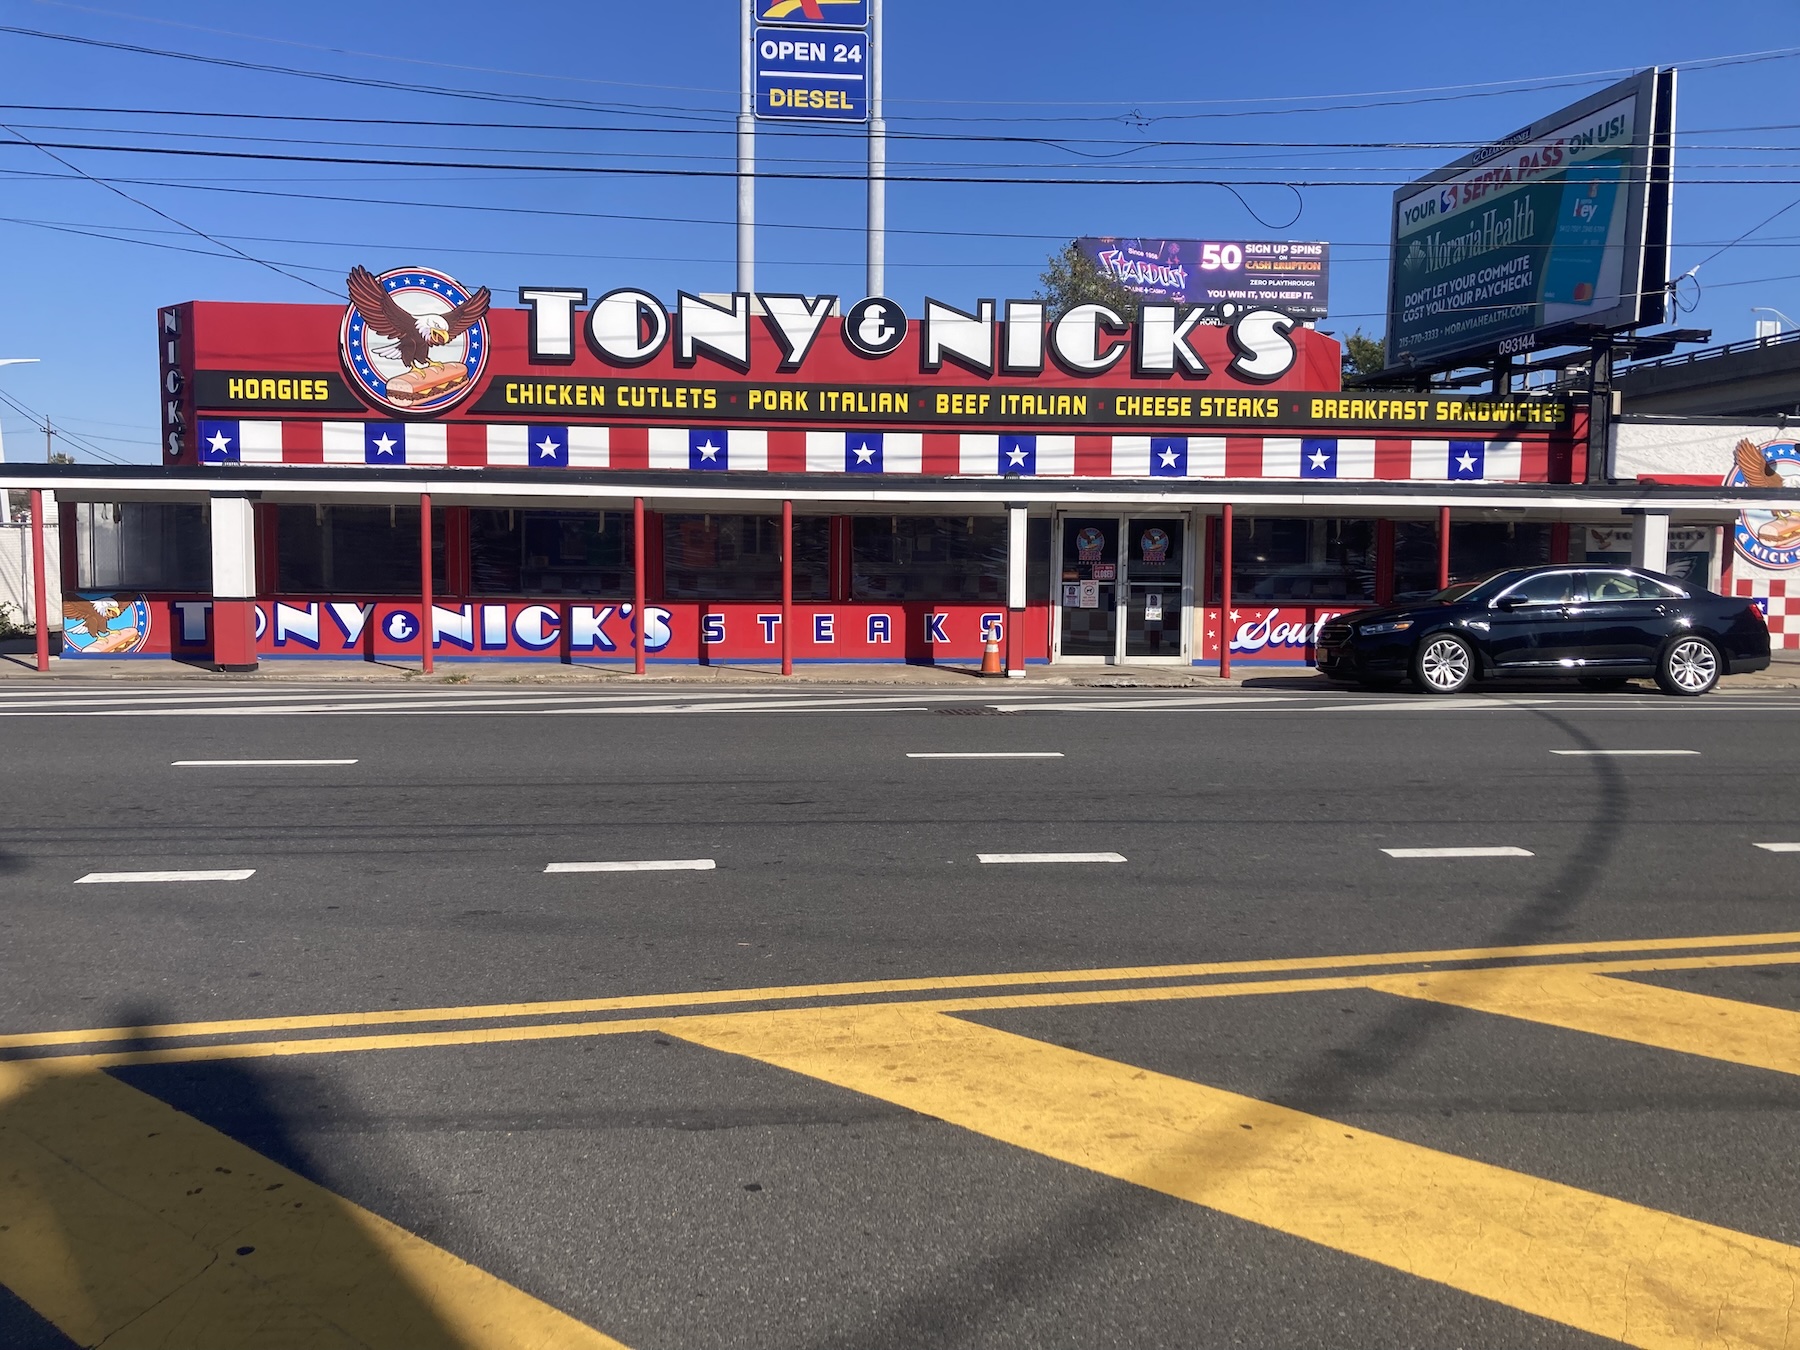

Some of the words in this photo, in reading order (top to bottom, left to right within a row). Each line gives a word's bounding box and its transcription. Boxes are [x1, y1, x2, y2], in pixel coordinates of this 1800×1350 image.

[760, 40, 826, 62] OPEN
[833, 44, 862, 63] 24
[769, 88, 854, 110] DIESEL
[1404, 199, 1436, 226] YOUR
[1462, 164, 1512, 205] SEPTA
[1516, 139, 1564, 181] PASS
[1569, 128, 1594, 155] ON
[1597, 114, 1625, 143] US!
[1128, 247, 1145, 257] Since
[1200, 243, 1243, 272] 50
[1245, 245, 1271, 255] SIGN
[1273, 245, 1288, 255] UP
[1290, 245, 1323, 255] SPINS
[1245, 261, 1271, 271] CASH
[1273, 261, 1322, 271] ERUPTION
[1404, 287, 1431, 308] DON'T
[1432, 279, 1449, 299] LET
[1449, 273, 1477, 293] YOUR
[1478, 255, 1530, 284] COMMUTE
[1207, 290, 1226, 299] YOU
[1227, 291, 1246, 299] WIN
[1247, 291, 1258, 300] IT,
[1258, 291, 1278, 300] YOU
[1278, 292, 1301, 300] KEEP
[1301, 292, 1314, 300] IT.
[1402, 306, 1427, 324] COST
[1426, 301, 1446, 319] YOU
[1447, 294, 1474, 313] YOUR
[1475, 271, 1532, 304] PAYCHECK!
[518, 286, 838, 375] TONY
[852, 299, 902, 351] &
[921, 296, 1297, 383] NICK'S
[1399, 328, 1439, 349] 215-770-3333
[1445, 305, 1530, 336] MORAVIAHEALTH.COM
[1499, 333, 1536, 356] 093144
[228, 378, 329, 401] HOAGIES
[505, 383, 605, 406] CHICKEN
[617, 386, 717, 409] CUTLETS
[748, 390, 809, 411] PORK
[819, 391, 909, 414] ITALIAN
[936, 393, 991, 414] BEEF
[1000, 394, 1088, 415] ITALIAN
[1115, 396, 1192, 417] CHEESE
[1200, 397, 1279, 418] STEAKS
[1311, 398, 1429, 420] BREAKFAST
[1436, 401, 1566, 423] SANDWICHES
[383, 611, 419, 642] &
[432, 602, 673, 654] NICK'S
